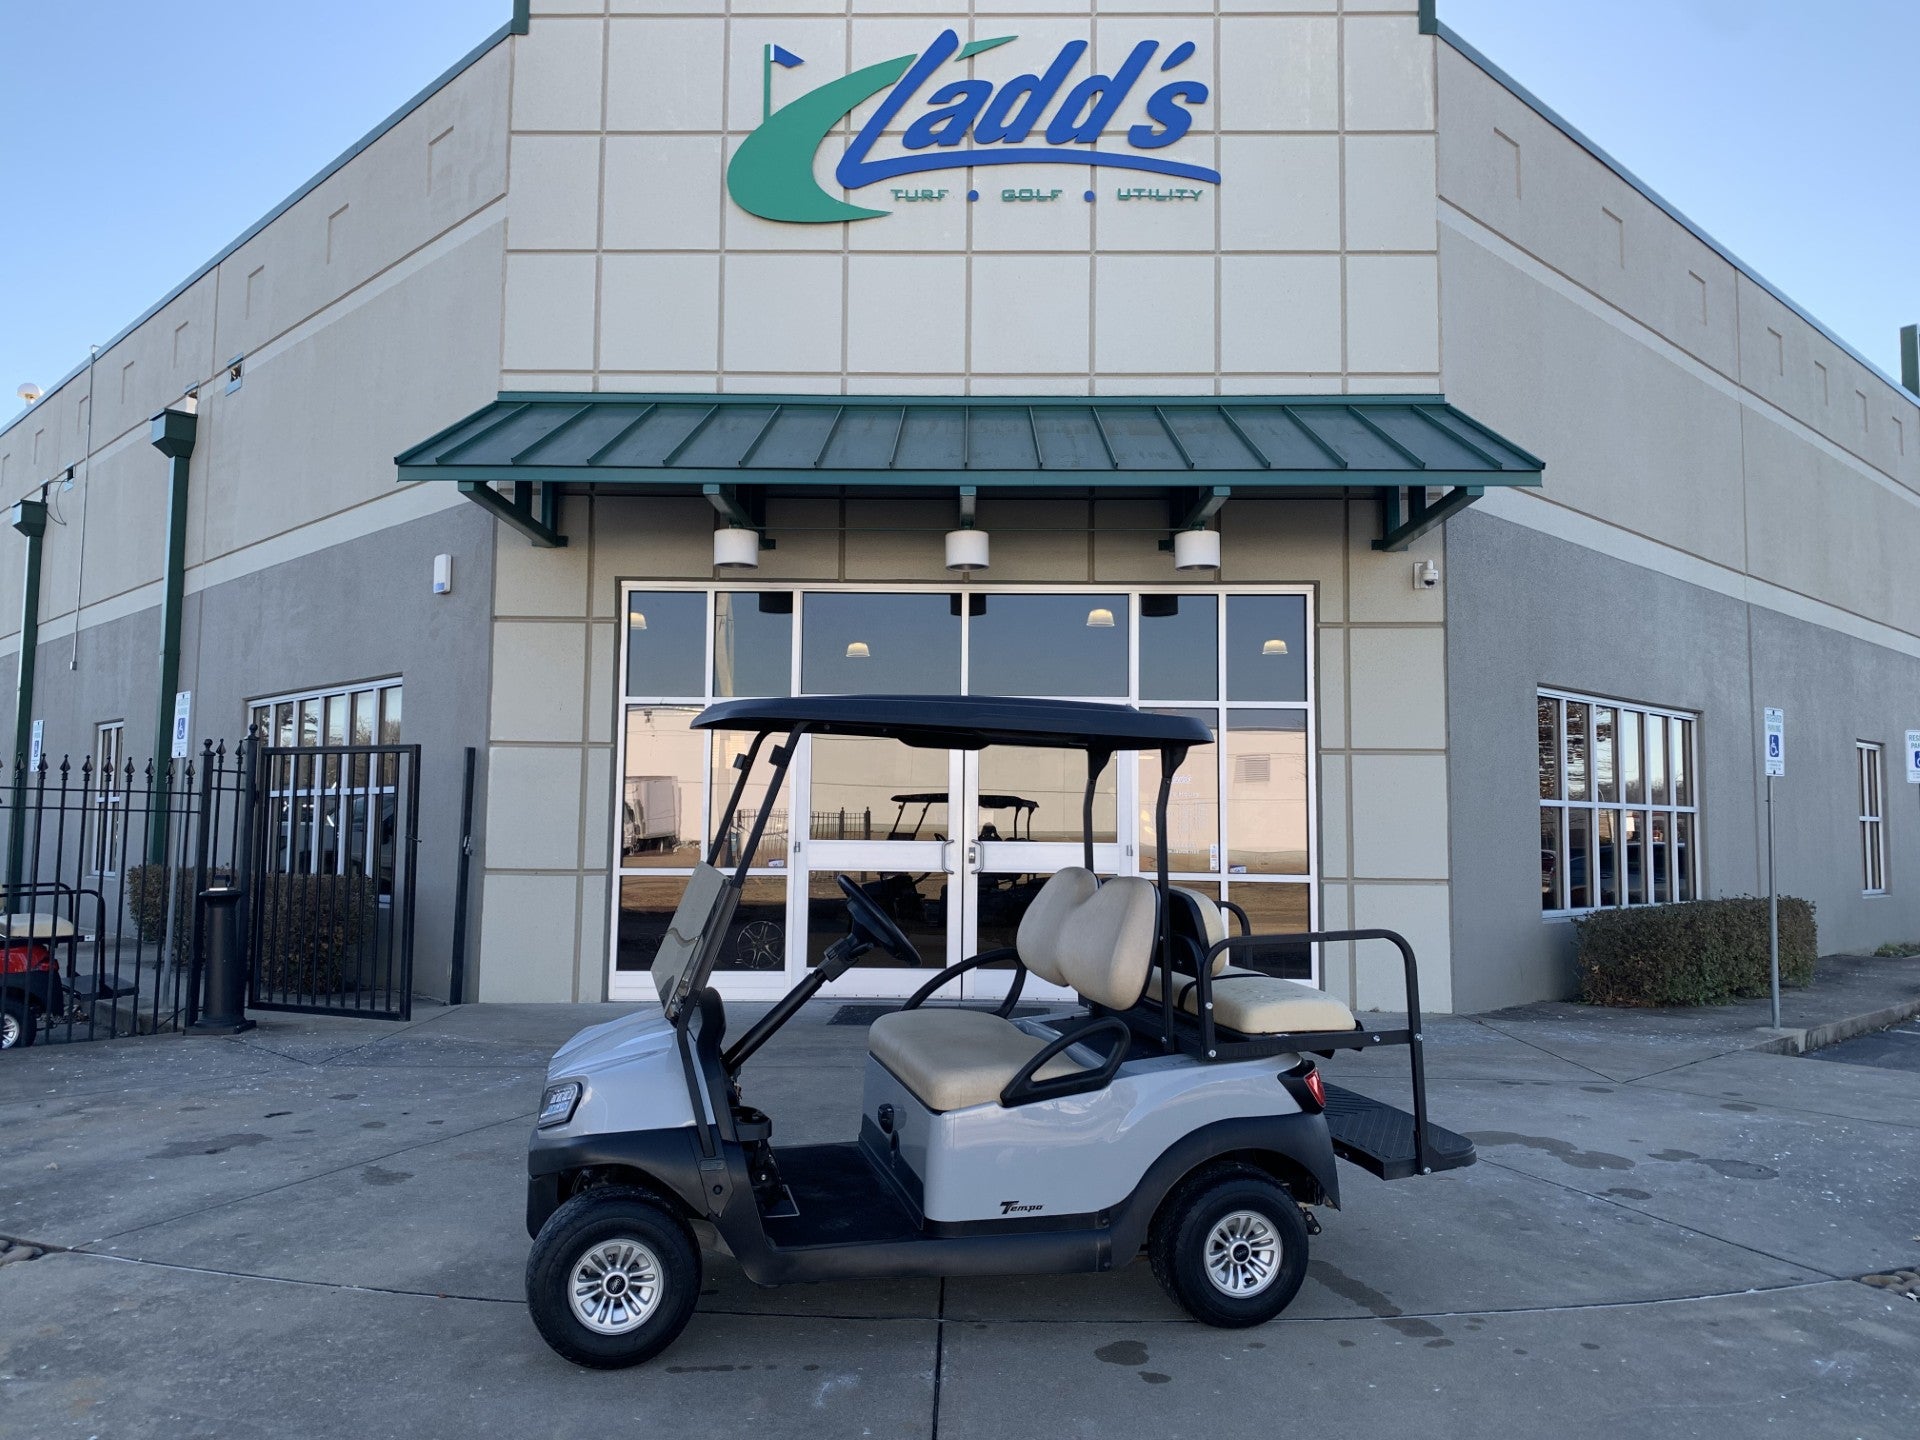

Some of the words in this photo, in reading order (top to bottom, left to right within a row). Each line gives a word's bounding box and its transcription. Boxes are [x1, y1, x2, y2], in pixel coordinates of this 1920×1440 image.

[836, 29, 1220, 189] Ladd's
[890, 188, 949, 201] TURF
[1001, 188, 1062, 201] GOLF
[1117, 188, 1203, 201] UTILITY
[1000, 1200, 1043, 1215] Tempo
